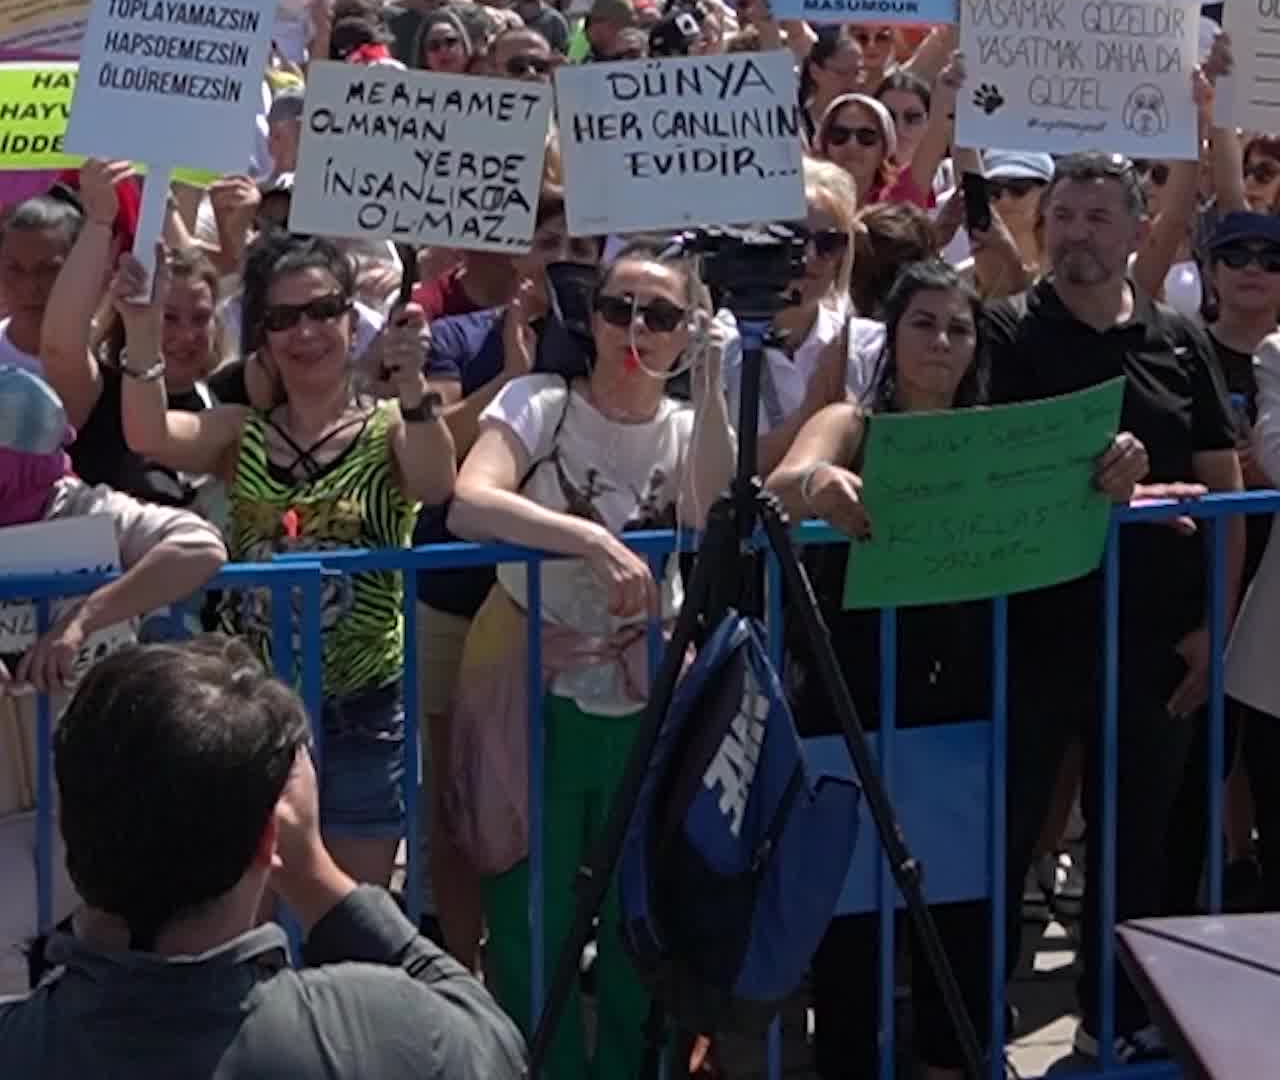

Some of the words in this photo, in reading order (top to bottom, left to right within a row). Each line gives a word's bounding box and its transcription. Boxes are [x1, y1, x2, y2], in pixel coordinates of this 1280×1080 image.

[802, 0, 918, 13] MASUMDUR
[103, 30, 250, 67] HAPSDEMEZSİN
[97, 62, 242, 103] ÖLDÜREMEZSİN
[607, 58, 776, 101] DÜNYA
[310, 109, 447, 143] OLMAYAN
[573, 113, 644, 144] HER
[650, 103, 801, 139] CANLININ
[414, 149, 526, 185] YERDE
